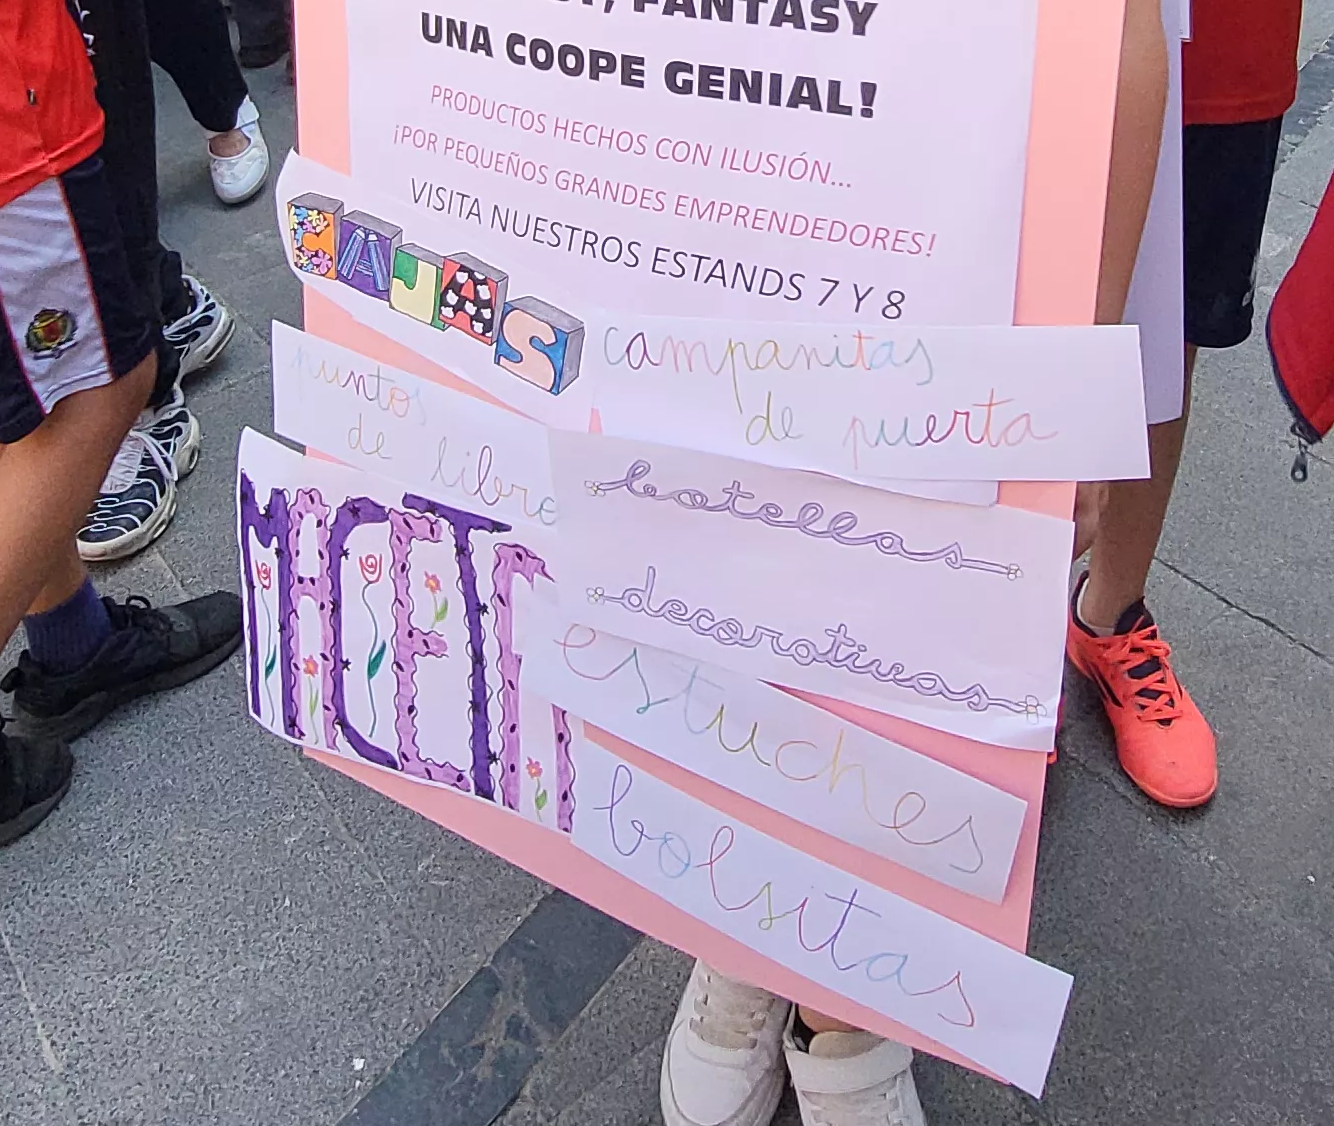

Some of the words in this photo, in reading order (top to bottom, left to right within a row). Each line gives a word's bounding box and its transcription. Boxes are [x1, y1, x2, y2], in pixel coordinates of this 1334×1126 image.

[421, 12, 494, 58] UNA
[505, 32, 645, 88] COOPE
[664, 60, 878, 118] GENIAL!
[394, 125, 438, 153] ¡POR
[444, 137, 548, 185] PEQUEÑOS
[555, 170, 666, 212] GRANDES
[674, 194, 937, 257] EMPRENDEDORES!
[431, 85, 547, 134] PRODUCTOS
[553, 117, 648, 155] HECHOS
[655, 138, 713, 167] CON
[720, 146, 851, 188] ILUSIÓN...
[288, 193, 585, 396] CAJAS
[411, 178, 482, 224] VISITA
[491, 205, 642, 268] NUESTROS
[651, 247, 806, 302] ESTANDS
[817, 278, 840, 307] 7
[852, 283, 874, 313] Y
[881, 290, 906, 320] 8
[292, 346, 427, 425] puntos
[603, 326, 934, 415] campanitas
[348, 413, 392, 460] de
[745, 391, 804, 446] de
[843, 388, 1059, 471] puerta
[603, 459, 967, 570] botellas
[615, 566, 995, 712] decorativas
[553, 623, 984, 874] estuches
[593, 764, 975, 1027] bolsitas
